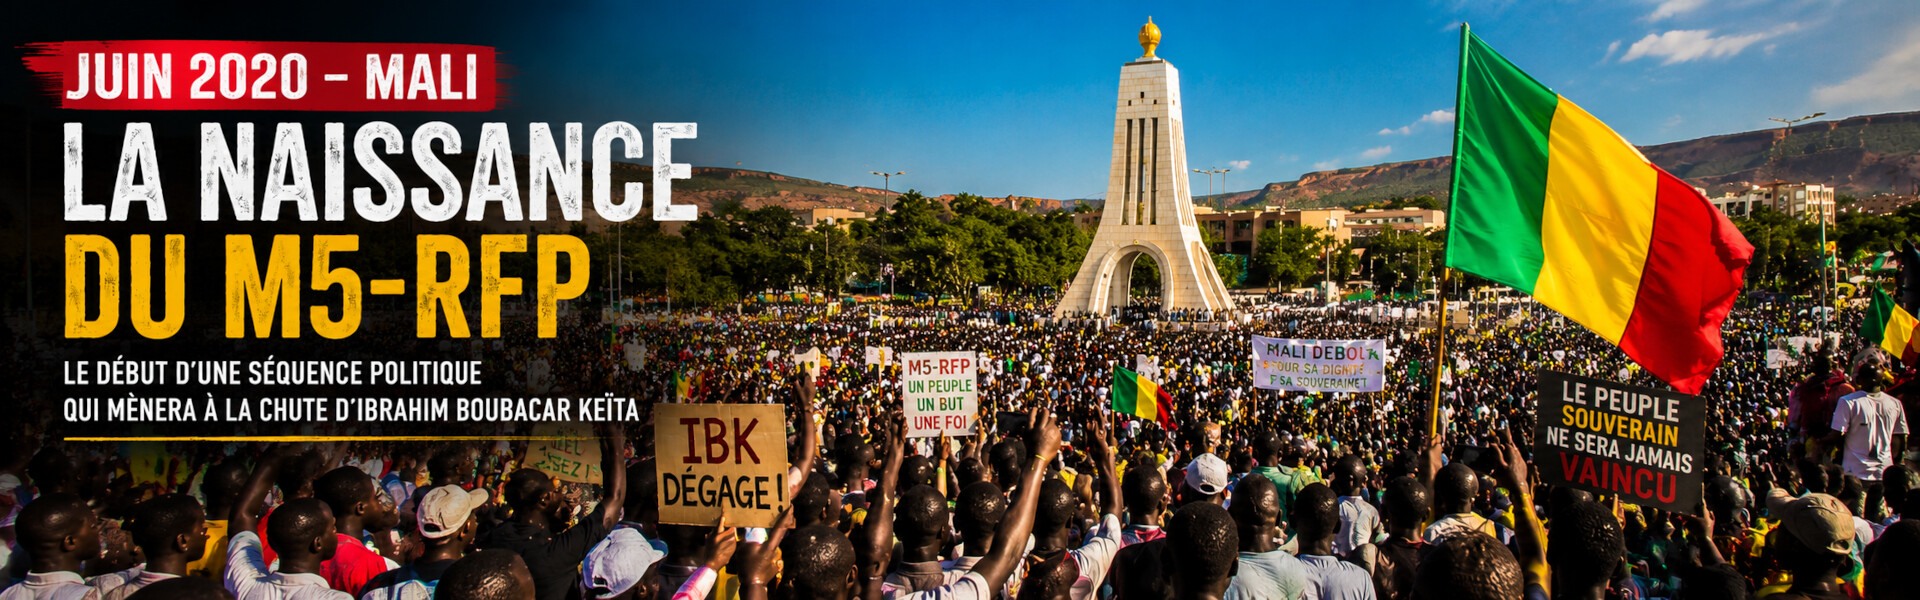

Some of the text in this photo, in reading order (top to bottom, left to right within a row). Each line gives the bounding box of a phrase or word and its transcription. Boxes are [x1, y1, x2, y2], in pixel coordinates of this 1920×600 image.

[908, 358, 970, 375] M5-RFP
[908, 379, 972, 393] UN PEUPLE
[914, 415, 966, 430] UNE FOI
[917, 396, 964, 411] UN BUT
[1562, 380, 1680, 423] LE PEUPLE
[680, 417, 761, 464] IBK
[1562, 404, 1679, 447] SOUVERAIN
[1546, 425, 1693, 474] NE SERA JAMAIS
[1560, 451, 1677, 503] VAINCU
